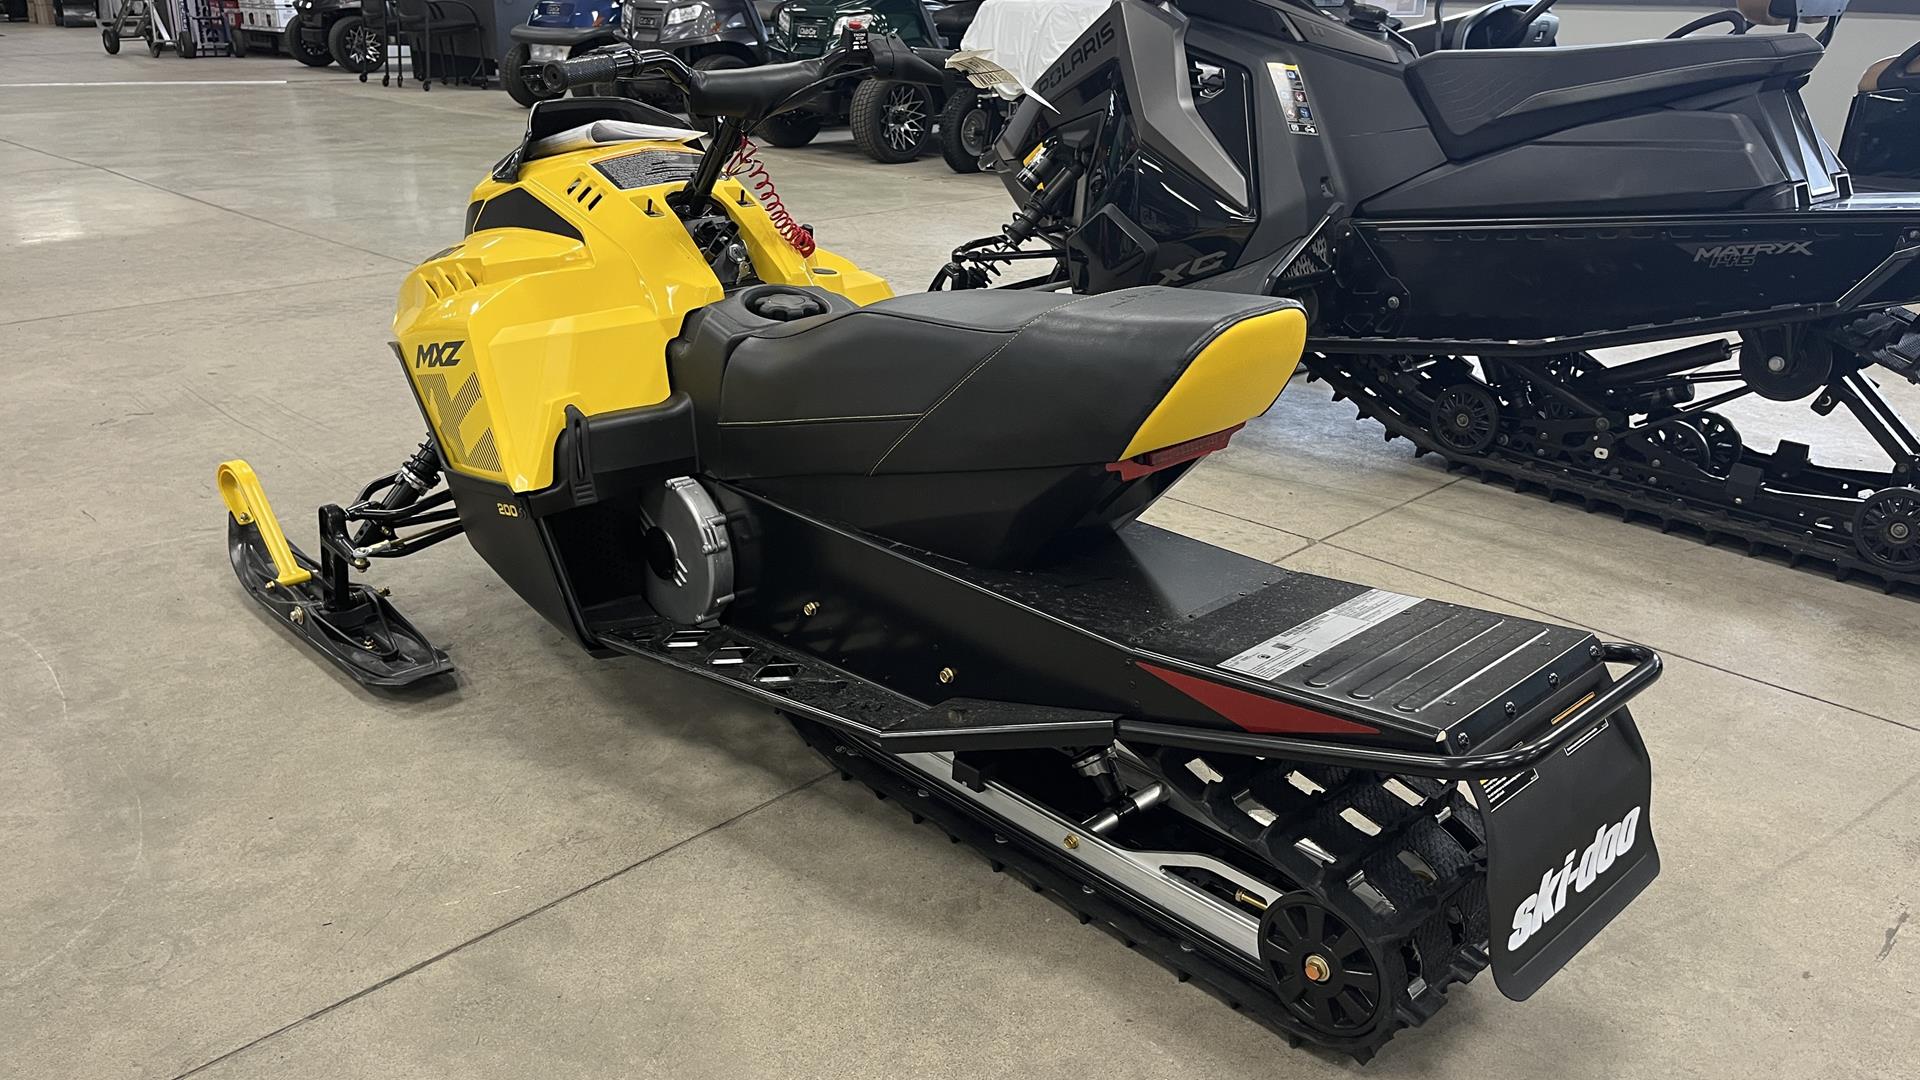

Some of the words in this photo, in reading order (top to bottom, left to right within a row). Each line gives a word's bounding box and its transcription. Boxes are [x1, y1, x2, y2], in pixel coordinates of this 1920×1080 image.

[1038, 20, 1116, 94] POLARIS
[1693, 240, 1814, 262] MATRYX
[1158, 250, 1228, 286] XC
[415, 340, 466, 368] MXZ
[496, 502, 519, 517] 200
[1507, 805, 1642, 952] ski-doo
